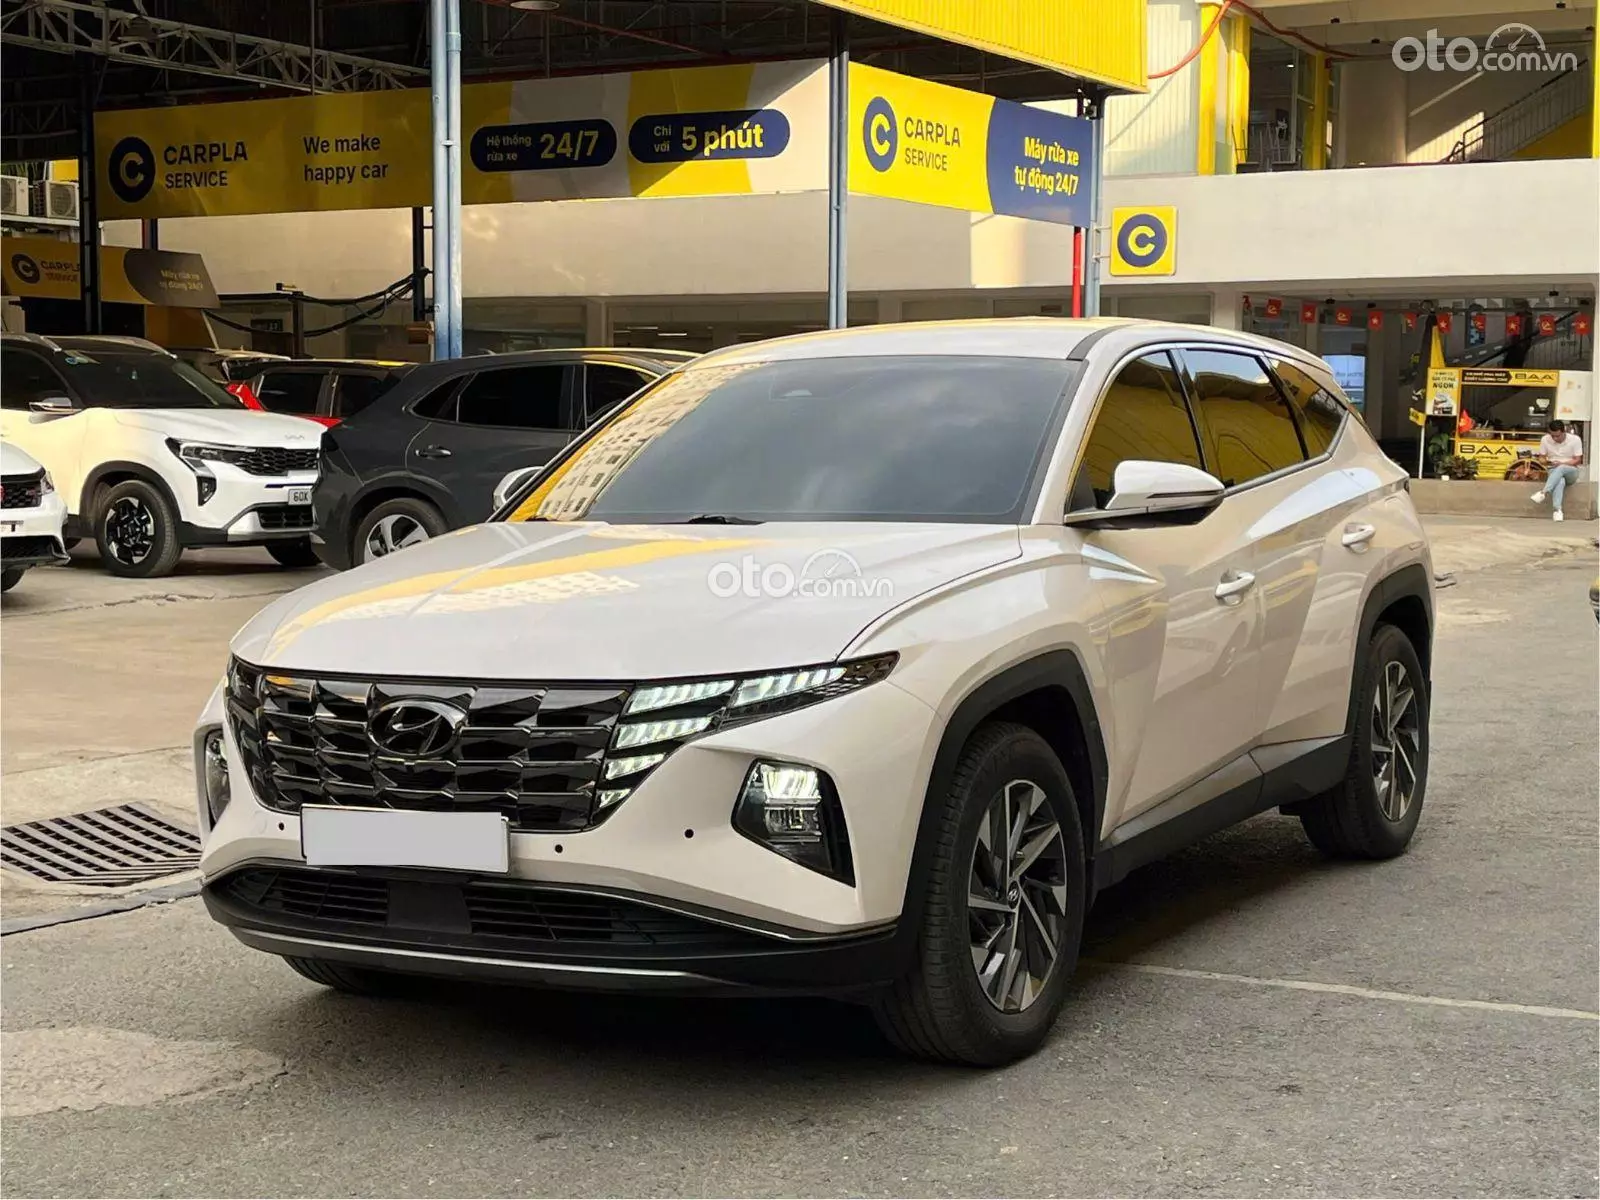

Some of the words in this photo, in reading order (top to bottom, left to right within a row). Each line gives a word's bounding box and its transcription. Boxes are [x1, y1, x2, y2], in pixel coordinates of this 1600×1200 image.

[303, 135, 330, 155] We
[334, 134, 381, 154] make
[485, 134, 501, 149] Hệ
[502, 133, 533, 148] thống
[681, 125, 698, 152] 5
[703, 120, 764, 157] phút
[904, 116, 961, 148] CARPLA
[163, 140, 249, 166] CARPLA
[506, 152, 518, 161] xe
[540, 130, 600, 161] 24/7
[1024, 136, 1047, 165] Máy
[1048, 141, 1066, 164] rửa
[1066, 149, 1080, 167] xe
[904, 147, 948, 172] SERVICE
[164, 170, 229, 190] SERVICE
[304, 164, 357, 185] happy
[360, 163, 389, 179] car
[1014, 165, 1027, 191] tự
[1028, 167, 1055, 196] động
[1055, 171, 1079, 196] 24/7
[1460, 444, 1512, 456] BAA
